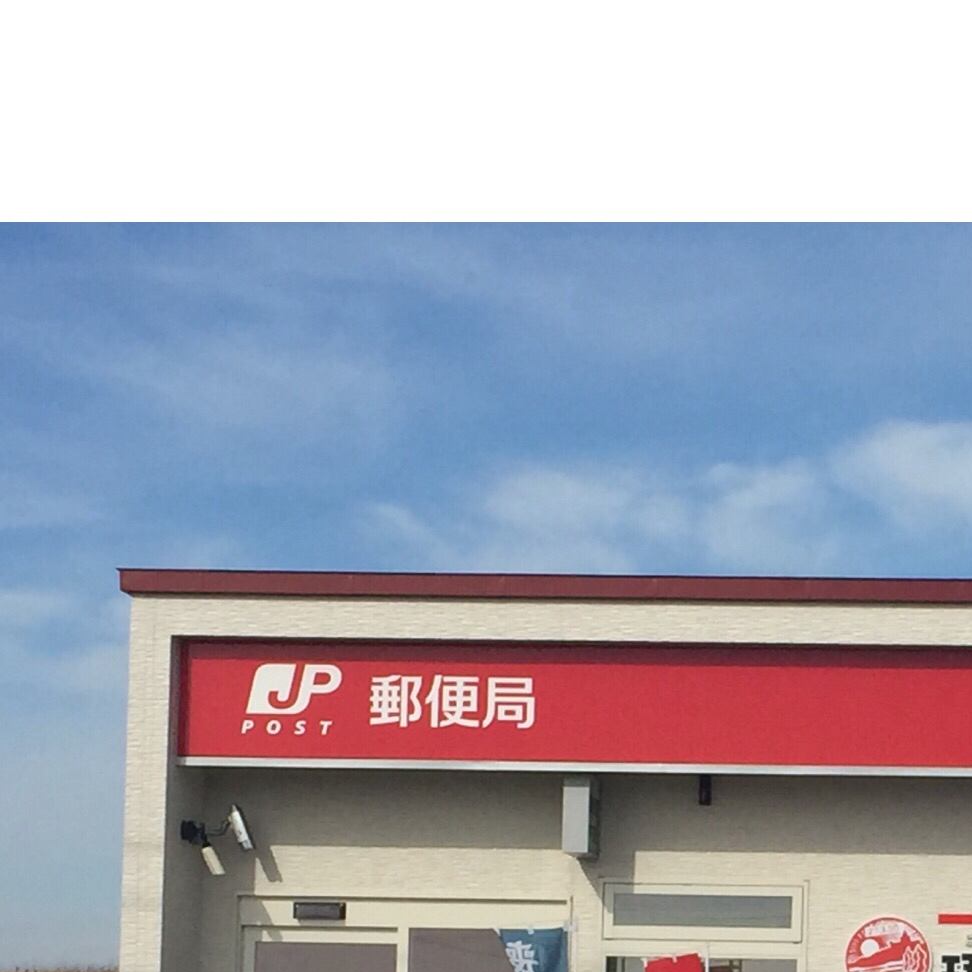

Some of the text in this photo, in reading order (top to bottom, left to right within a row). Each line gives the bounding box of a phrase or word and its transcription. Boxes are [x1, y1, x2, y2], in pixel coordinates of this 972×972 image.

[369, 674, 536, 729] 郵便局
[241, 720, 333, 735] POST
